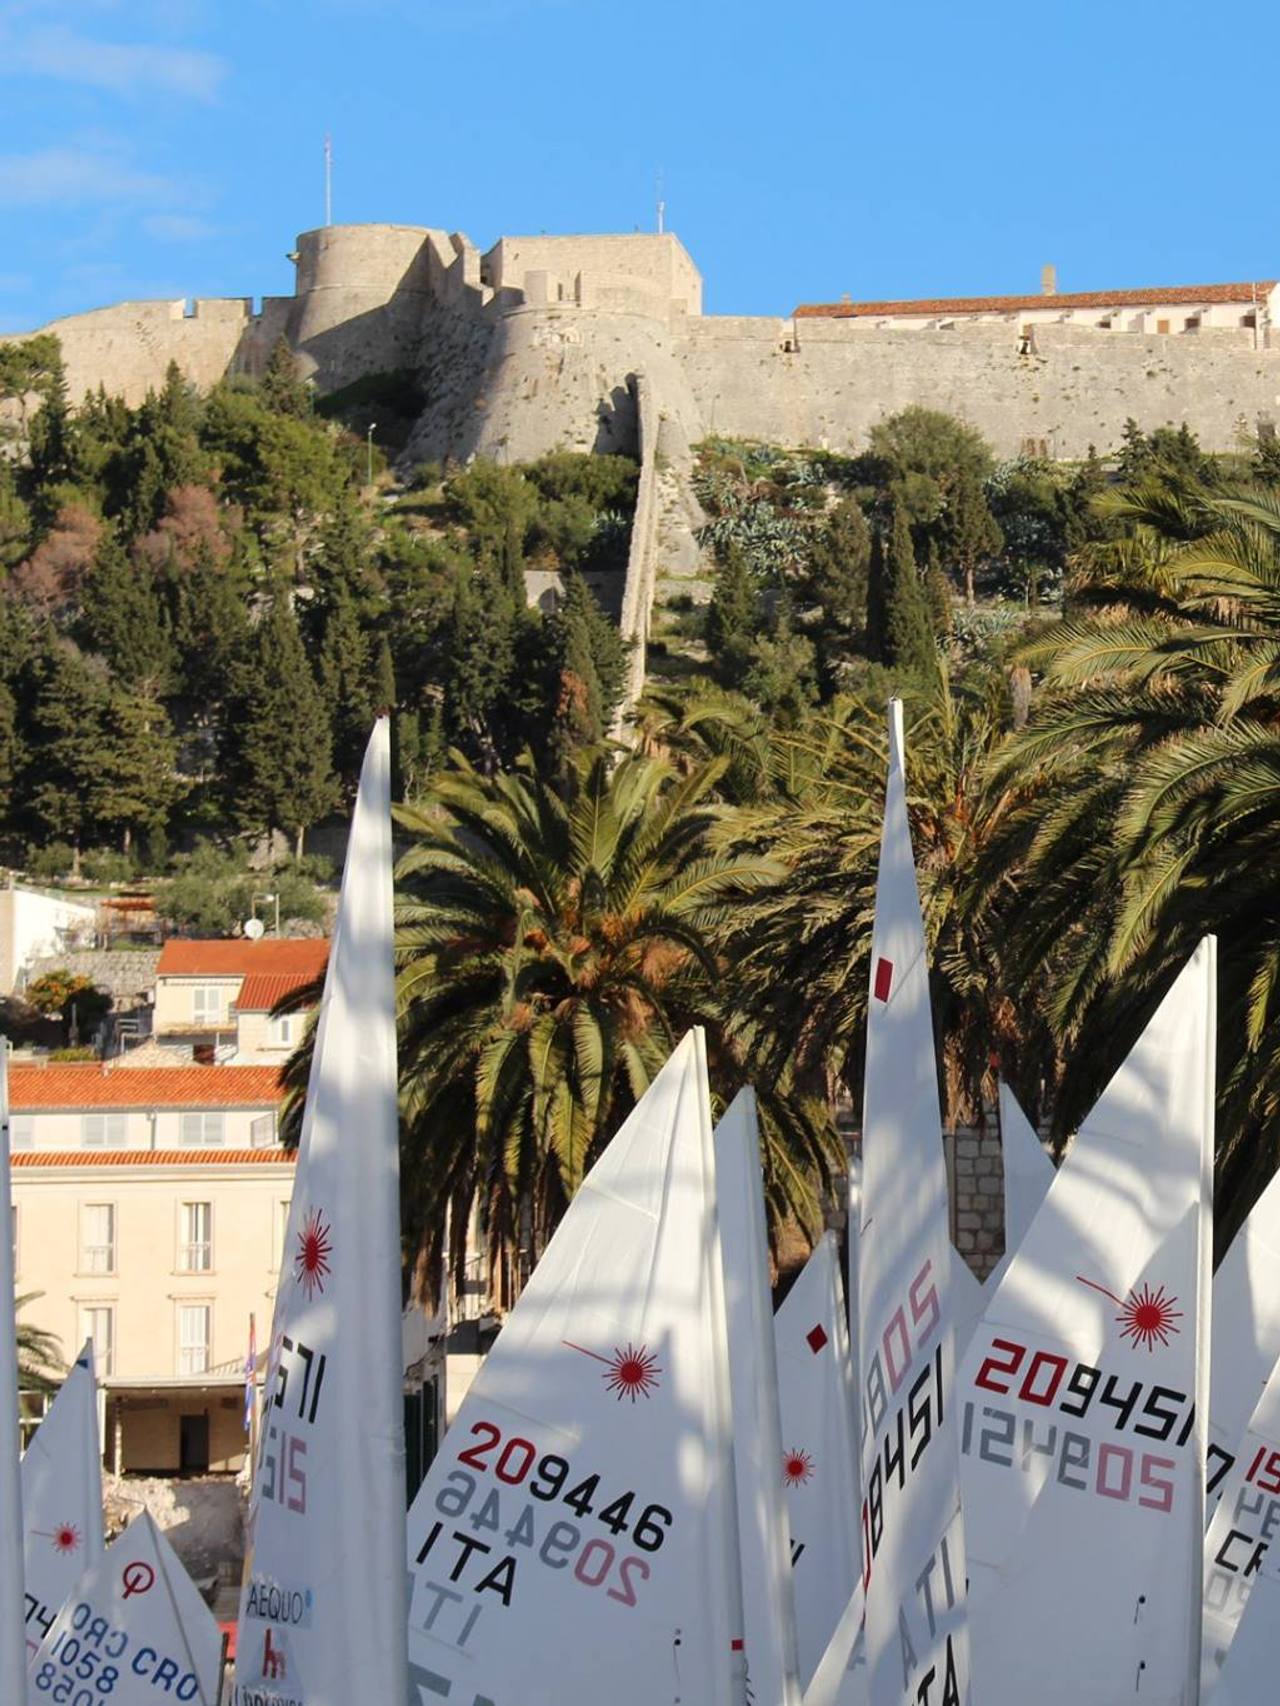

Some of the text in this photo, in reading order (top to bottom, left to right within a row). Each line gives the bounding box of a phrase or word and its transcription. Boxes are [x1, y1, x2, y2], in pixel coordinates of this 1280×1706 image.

[974, 1337, 1196, 1448] 209451
[457, 1420, 674, 1553] 209446
[416, 1520, 519, 1608] ITA
[246, 1584, 304, 1625] AEQUO
[51, 1630, 120, 1695] 1058
[131, 1647, 200, 1702] CRO
